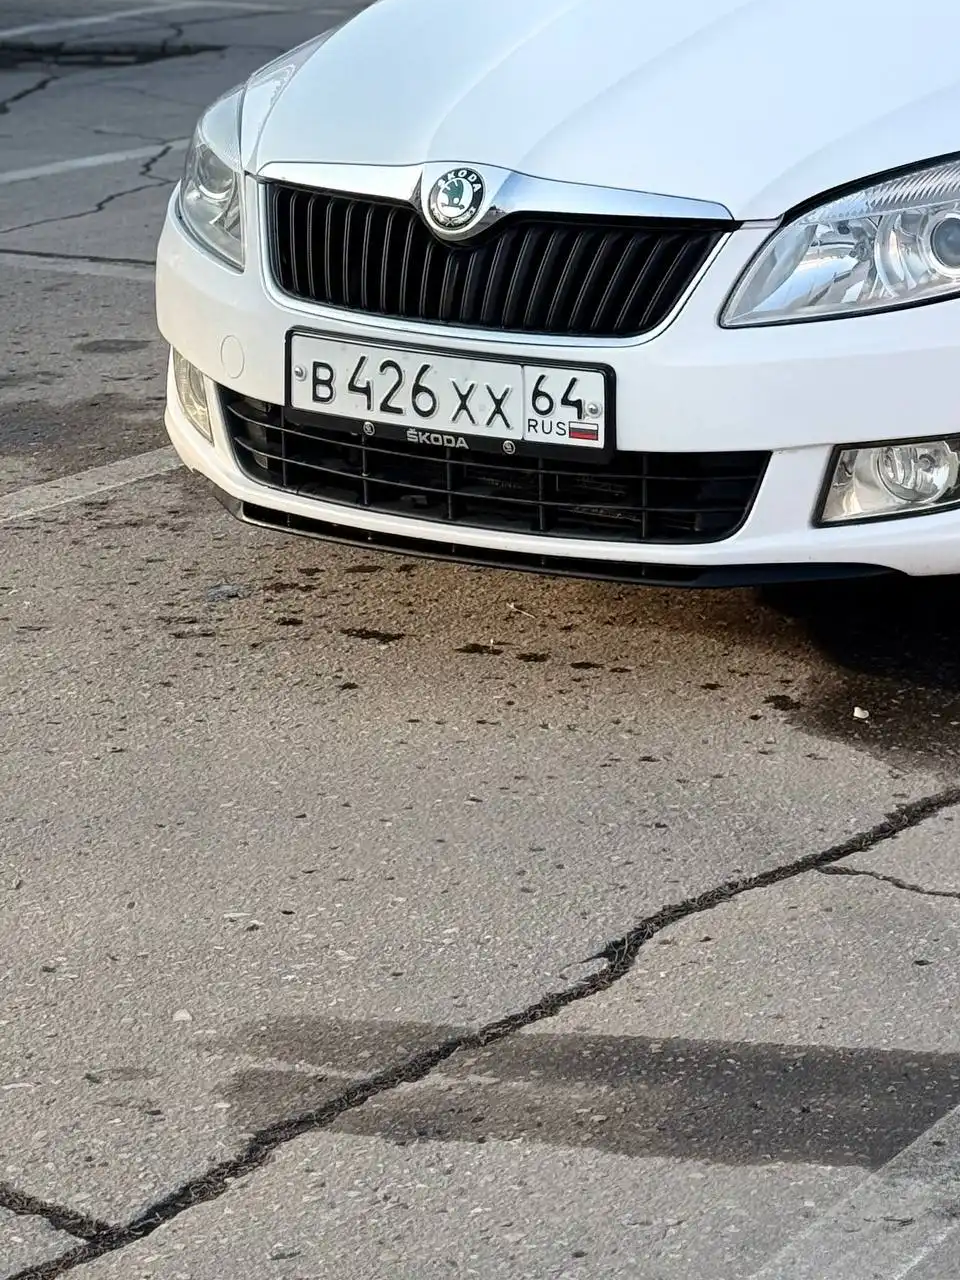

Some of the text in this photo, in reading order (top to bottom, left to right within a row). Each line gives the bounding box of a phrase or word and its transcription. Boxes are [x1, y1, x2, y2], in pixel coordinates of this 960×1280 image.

[531, 374, 584, 420] 64
[406, 428, 470, 450] ŠKODA
[527, 419, 568, 437] RUS
